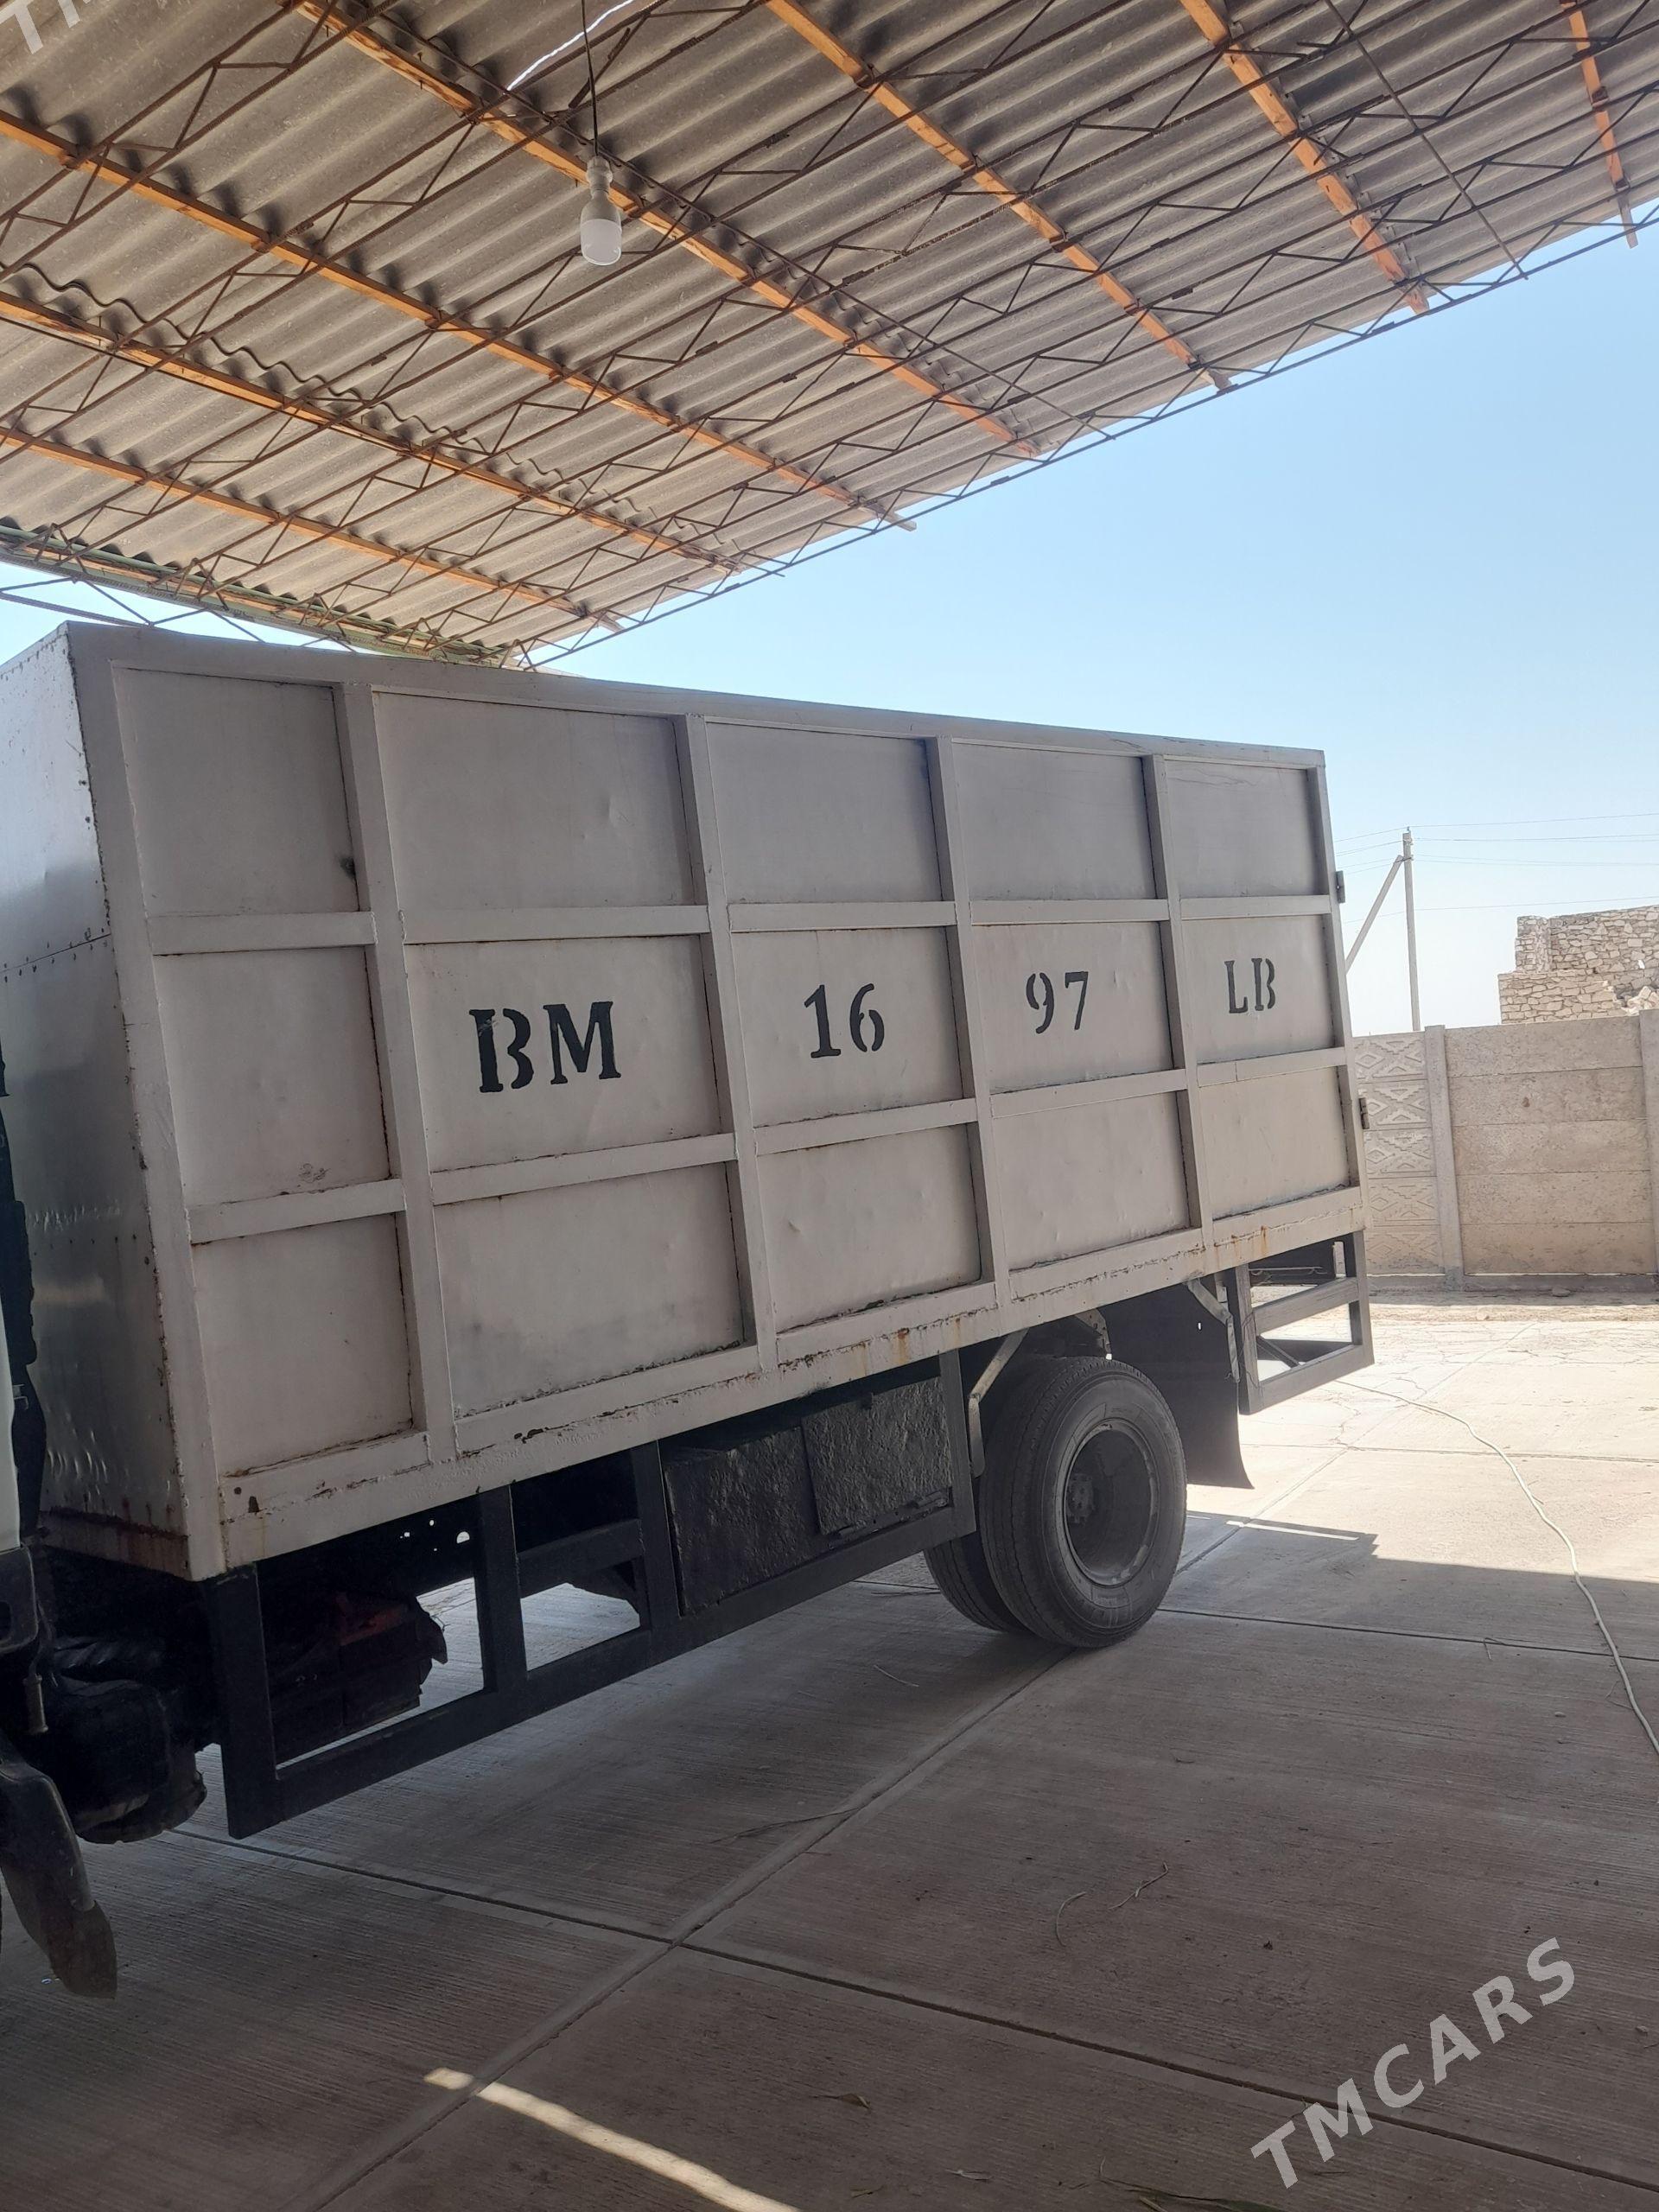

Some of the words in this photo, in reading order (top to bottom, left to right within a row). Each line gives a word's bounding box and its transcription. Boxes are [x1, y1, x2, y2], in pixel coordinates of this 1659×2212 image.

[469, 1001, 621, 1093] BM
[804, 983, 885, 1058] 16
[1026, 970, 1090, 1034] 97
[1224, 957, 1276, 1014] LB
